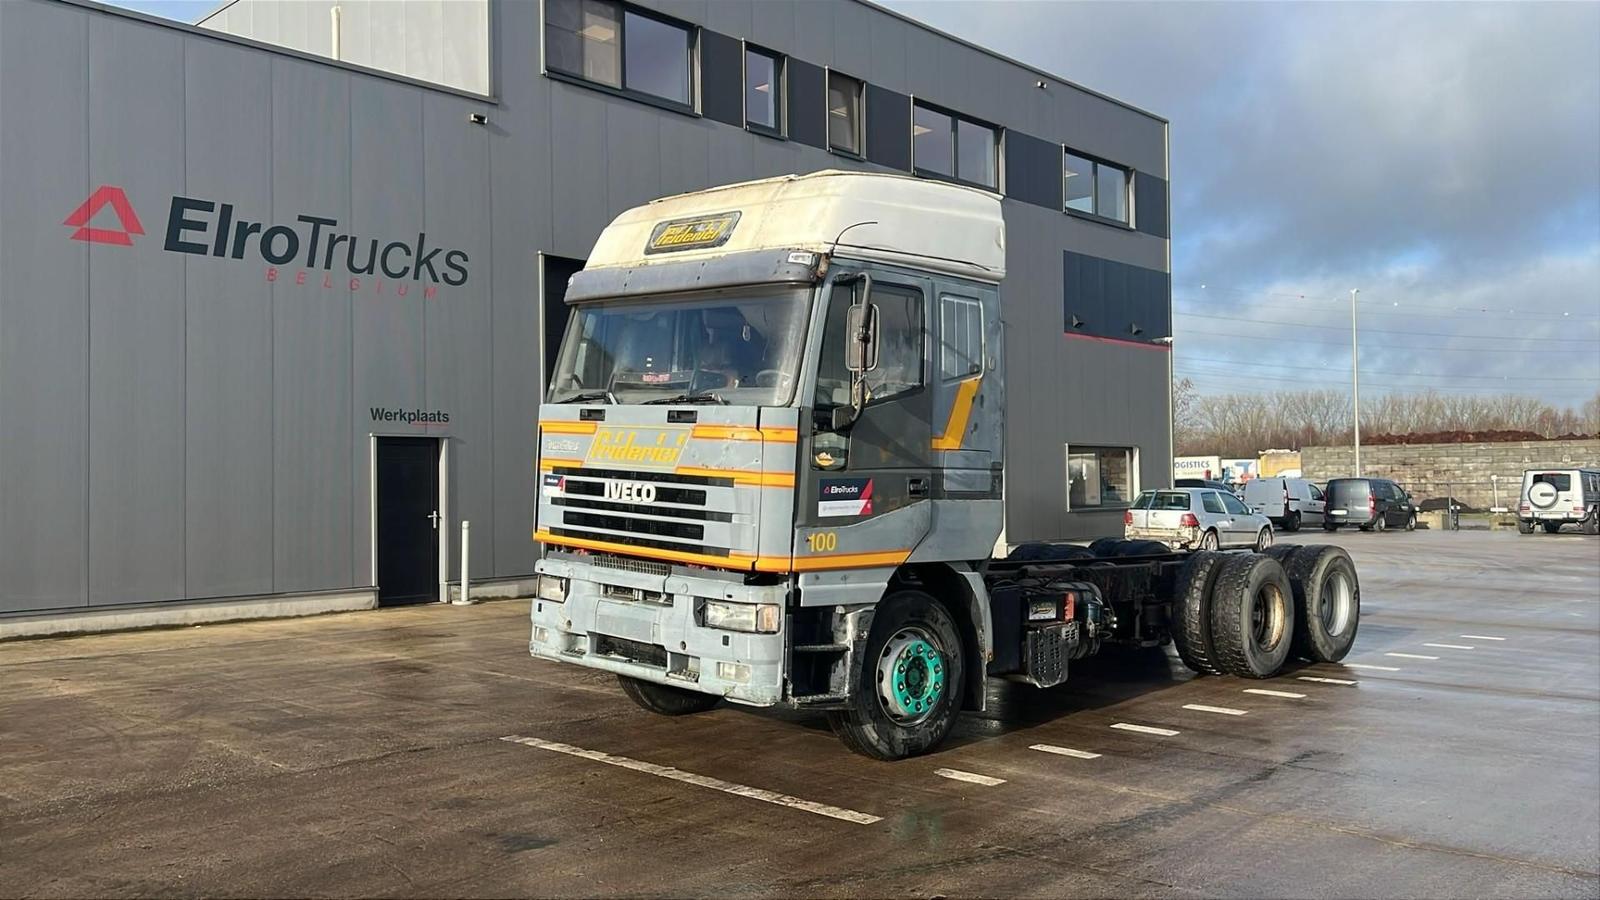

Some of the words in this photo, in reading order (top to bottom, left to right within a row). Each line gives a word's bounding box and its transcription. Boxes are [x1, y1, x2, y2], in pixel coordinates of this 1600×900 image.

[164, 195, 470, 286] ElroTrucks
[266, 267, 437, 300] BELGIUM
[371, 407, 449, 424] Werkplaats
[1174, 460, 1210, 469] OGISTICS
[604, 480, 656, 503] IVECO
[808, 532, 836, 552] 100
